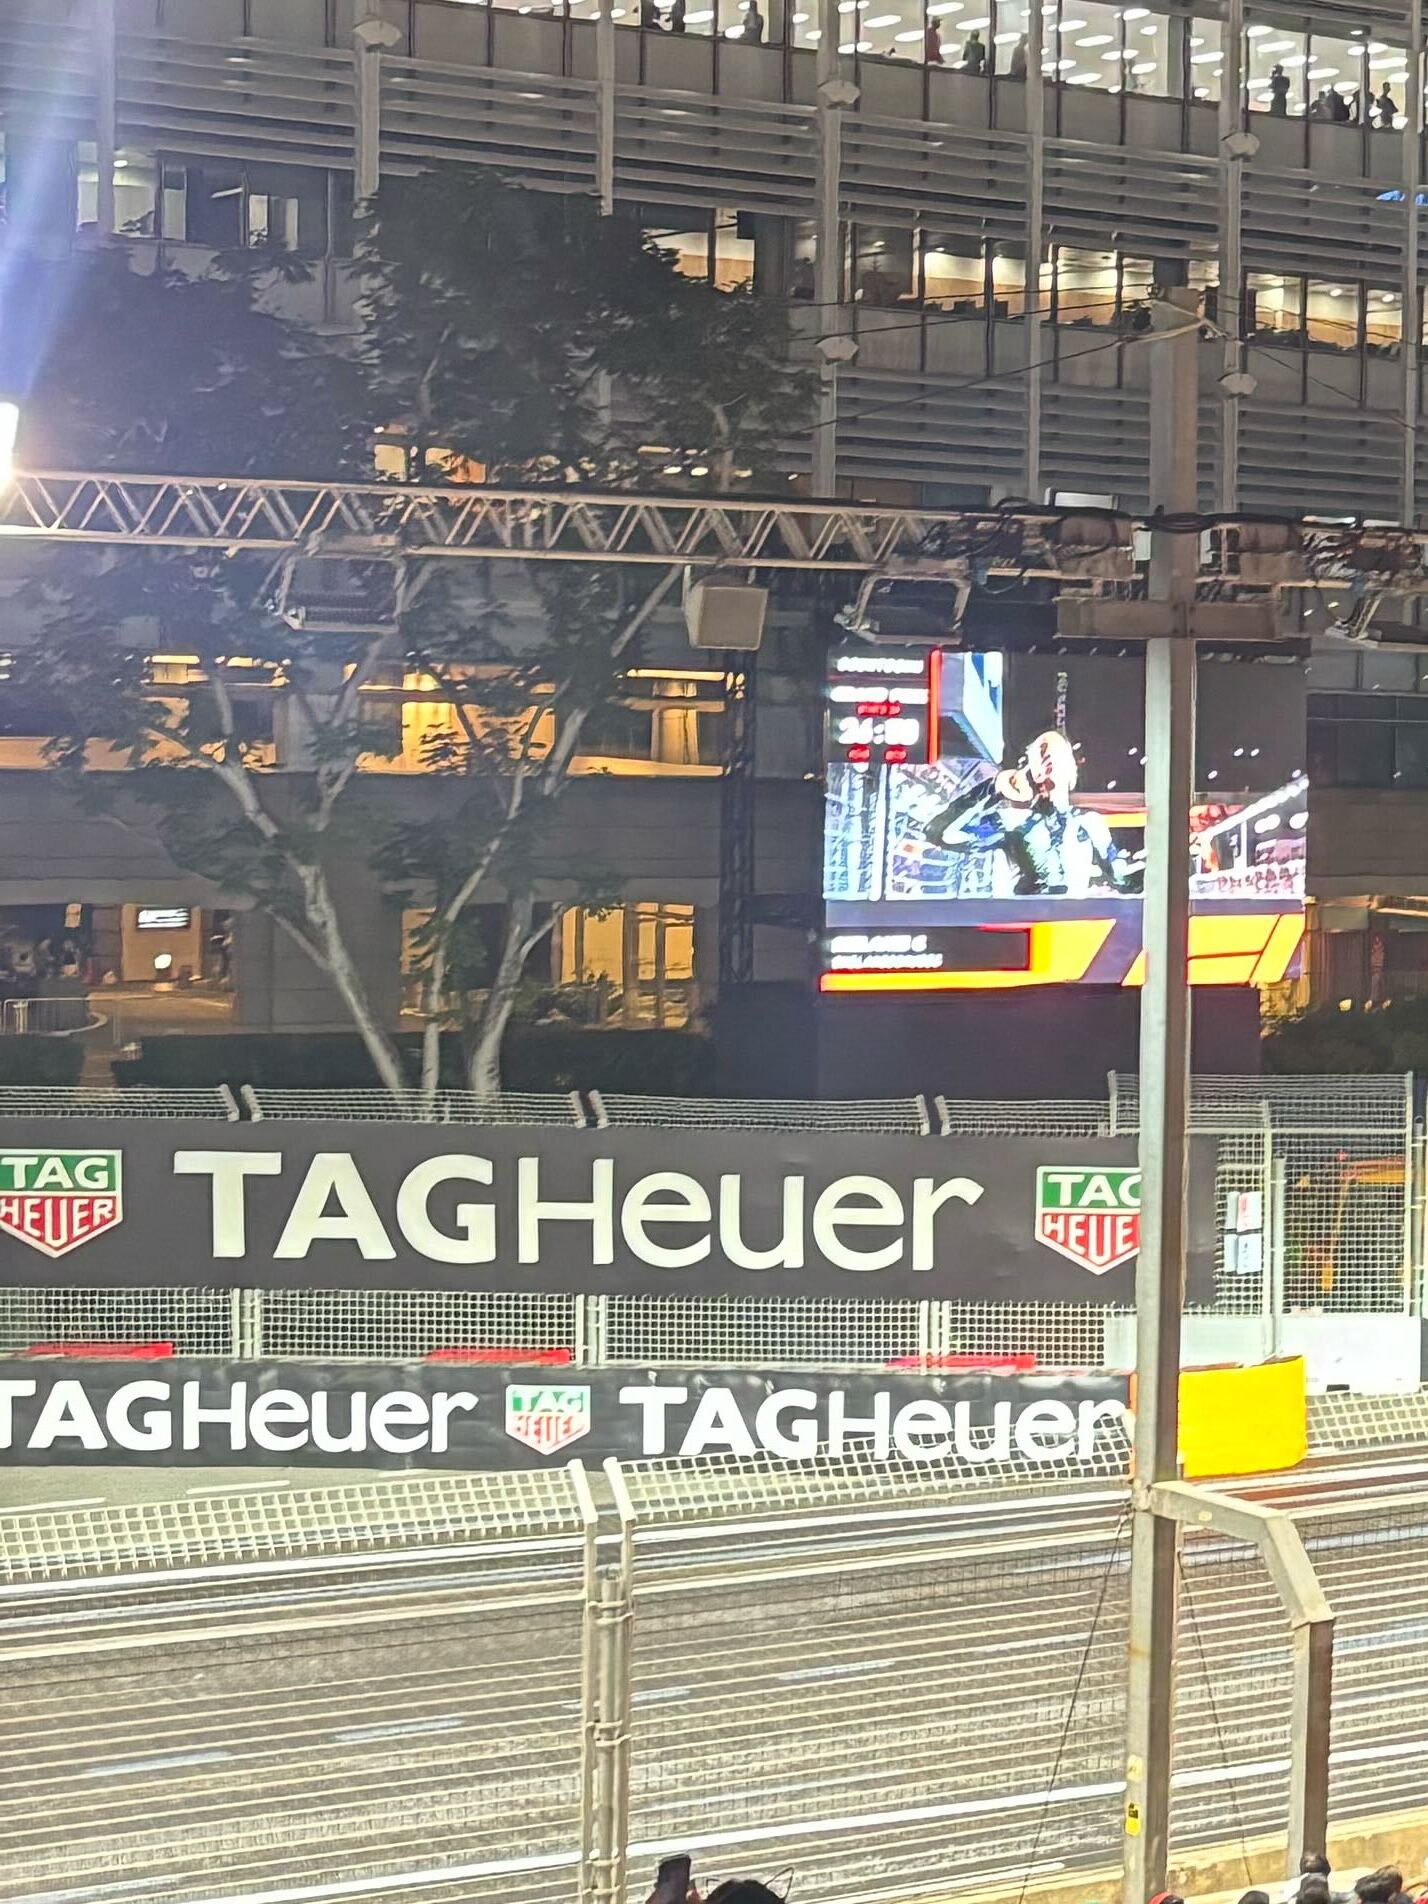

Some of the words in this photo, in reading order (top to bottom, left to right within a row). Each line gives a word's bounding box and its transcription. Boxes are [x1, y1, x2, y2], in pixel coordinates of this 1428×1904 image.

[1, 1156, 109, 1190] TAG
[0, 1198, 114, 1248] HEUER
[1043, 1214, 1134, 1266] HEUE
